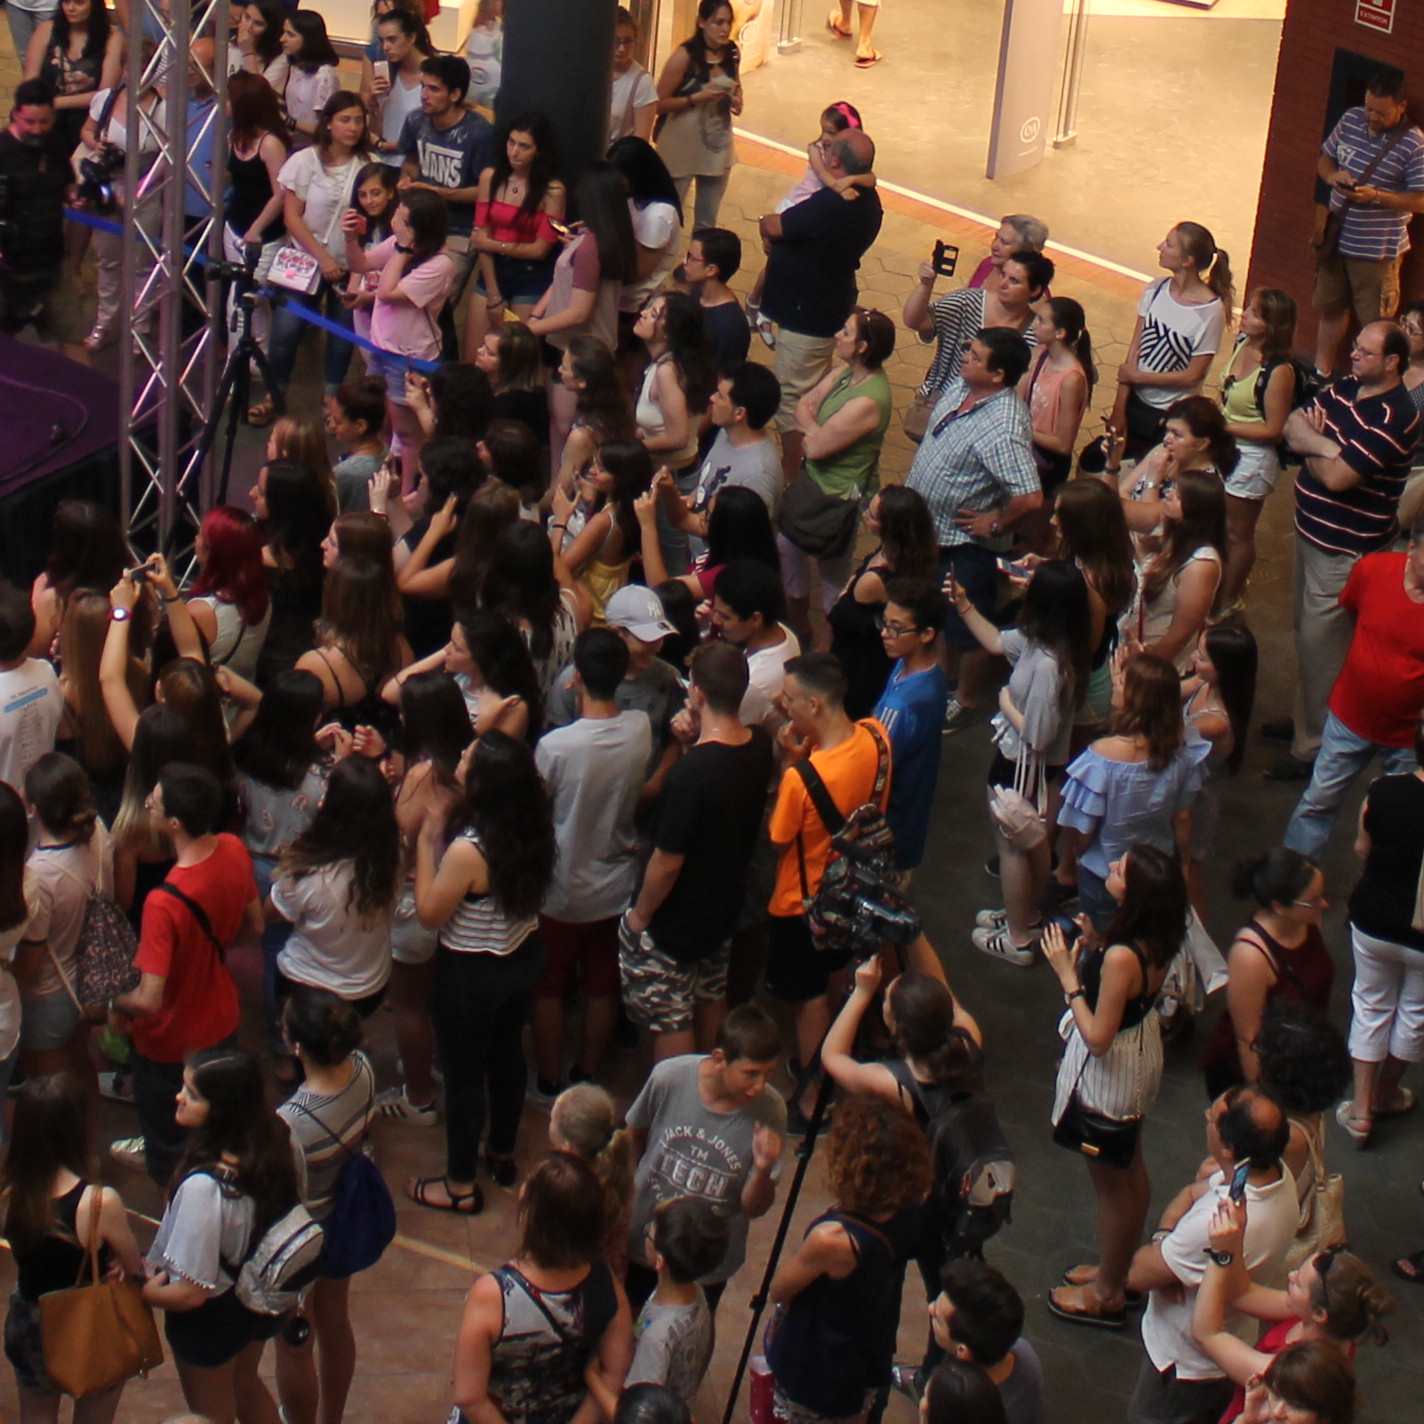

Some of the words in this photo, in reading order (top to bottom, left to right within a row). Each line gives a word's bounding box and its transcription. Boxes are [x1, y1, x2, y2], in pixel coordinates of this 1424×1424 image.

[417, 139, 464, 189] VANS
[664, 1125, 693, 1142] JACK
[707, 1135, 743, 1171] JONES
[690, 1144, 709, 1161] TM
[660, 1153, 729, 1197] TECH
